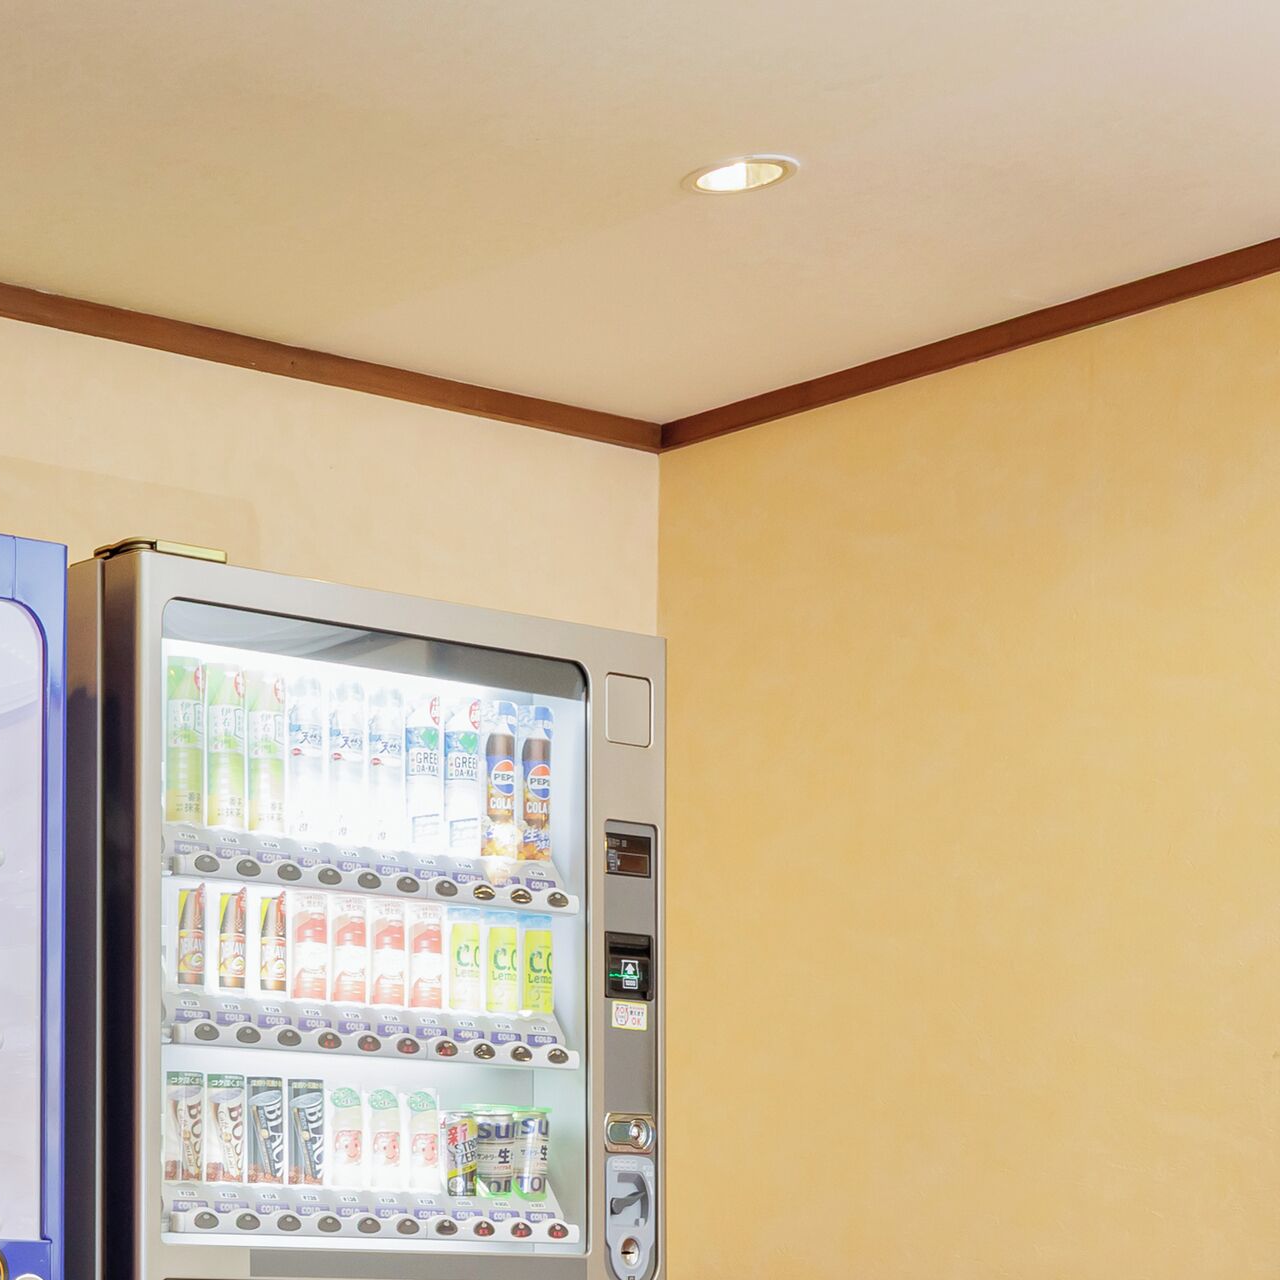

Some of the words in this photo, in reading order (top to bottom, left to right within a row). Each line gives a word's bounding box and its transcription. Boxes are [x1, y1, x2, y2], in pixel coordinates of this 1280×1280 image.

[490, 797, 513, 810] COLA
[526, 802, 548, 814] COLA
[448, 1123, 468, 1146] 新
